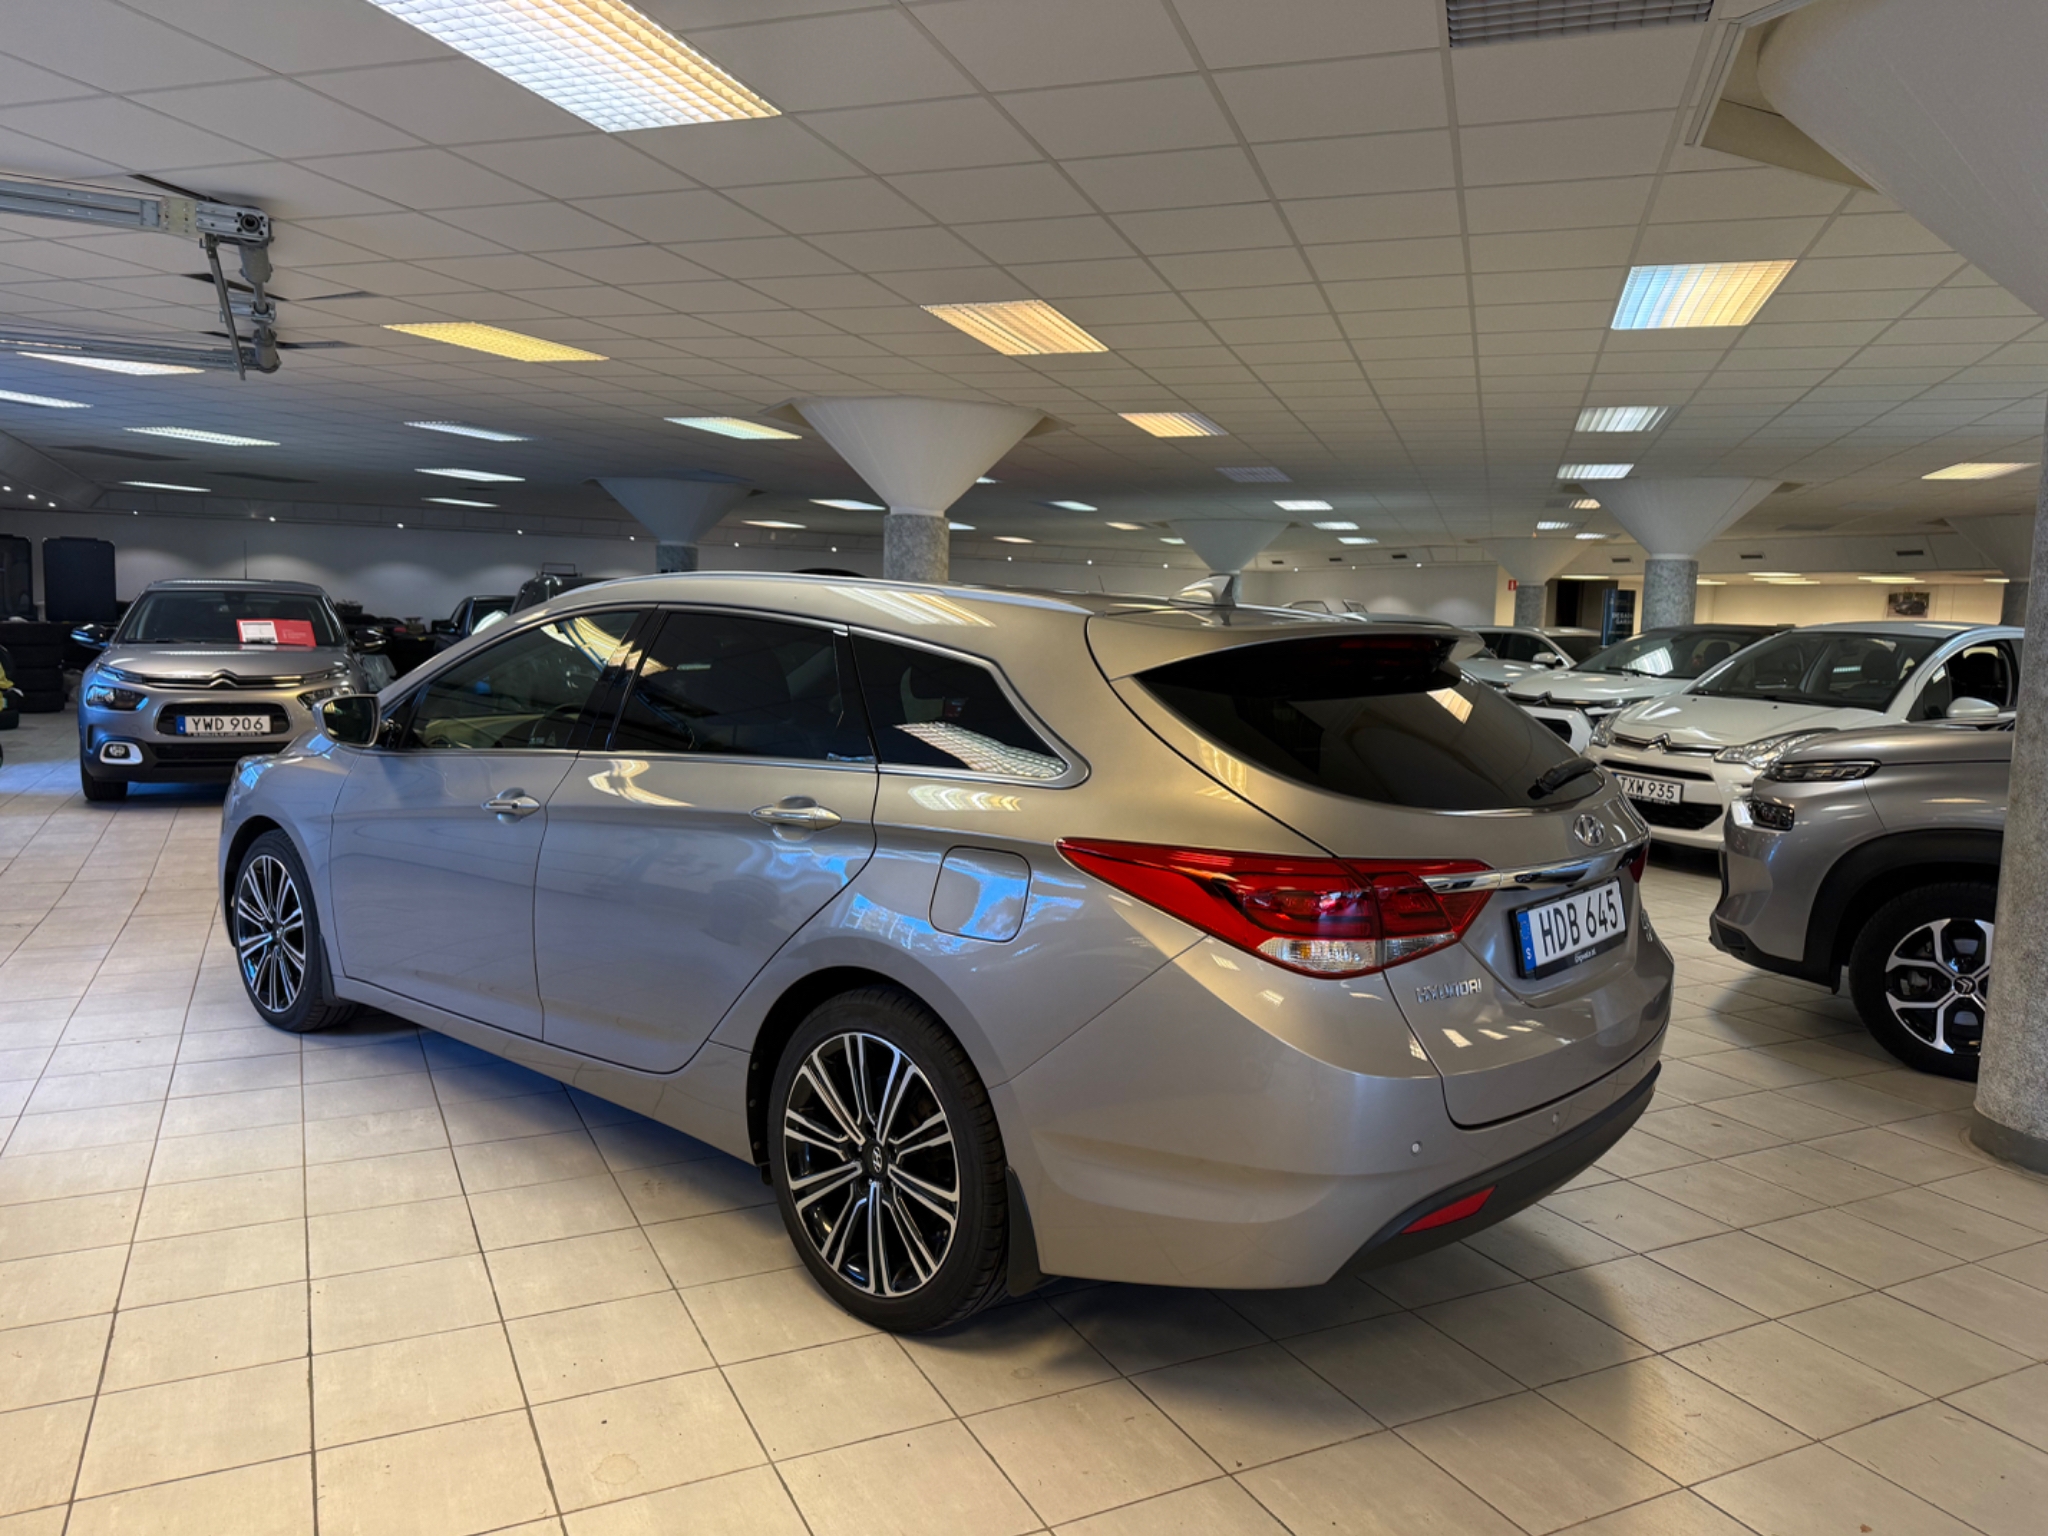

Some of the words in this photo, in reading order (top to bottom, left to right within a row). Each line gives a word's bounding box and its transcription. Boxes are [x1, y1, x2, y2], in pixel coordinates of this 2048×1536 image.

[192, 717, 224, 731] YWD
[230, 717, 263, 731] 906
[1620, 776, 1645, 794] TXW
[1648, 782, 1675, 800] 935
[1539, 902, 1580, 957] HDB
[1585, 888, 1618, 939] 645
[1415, 977, 1482, 1004] HYUNDAI
